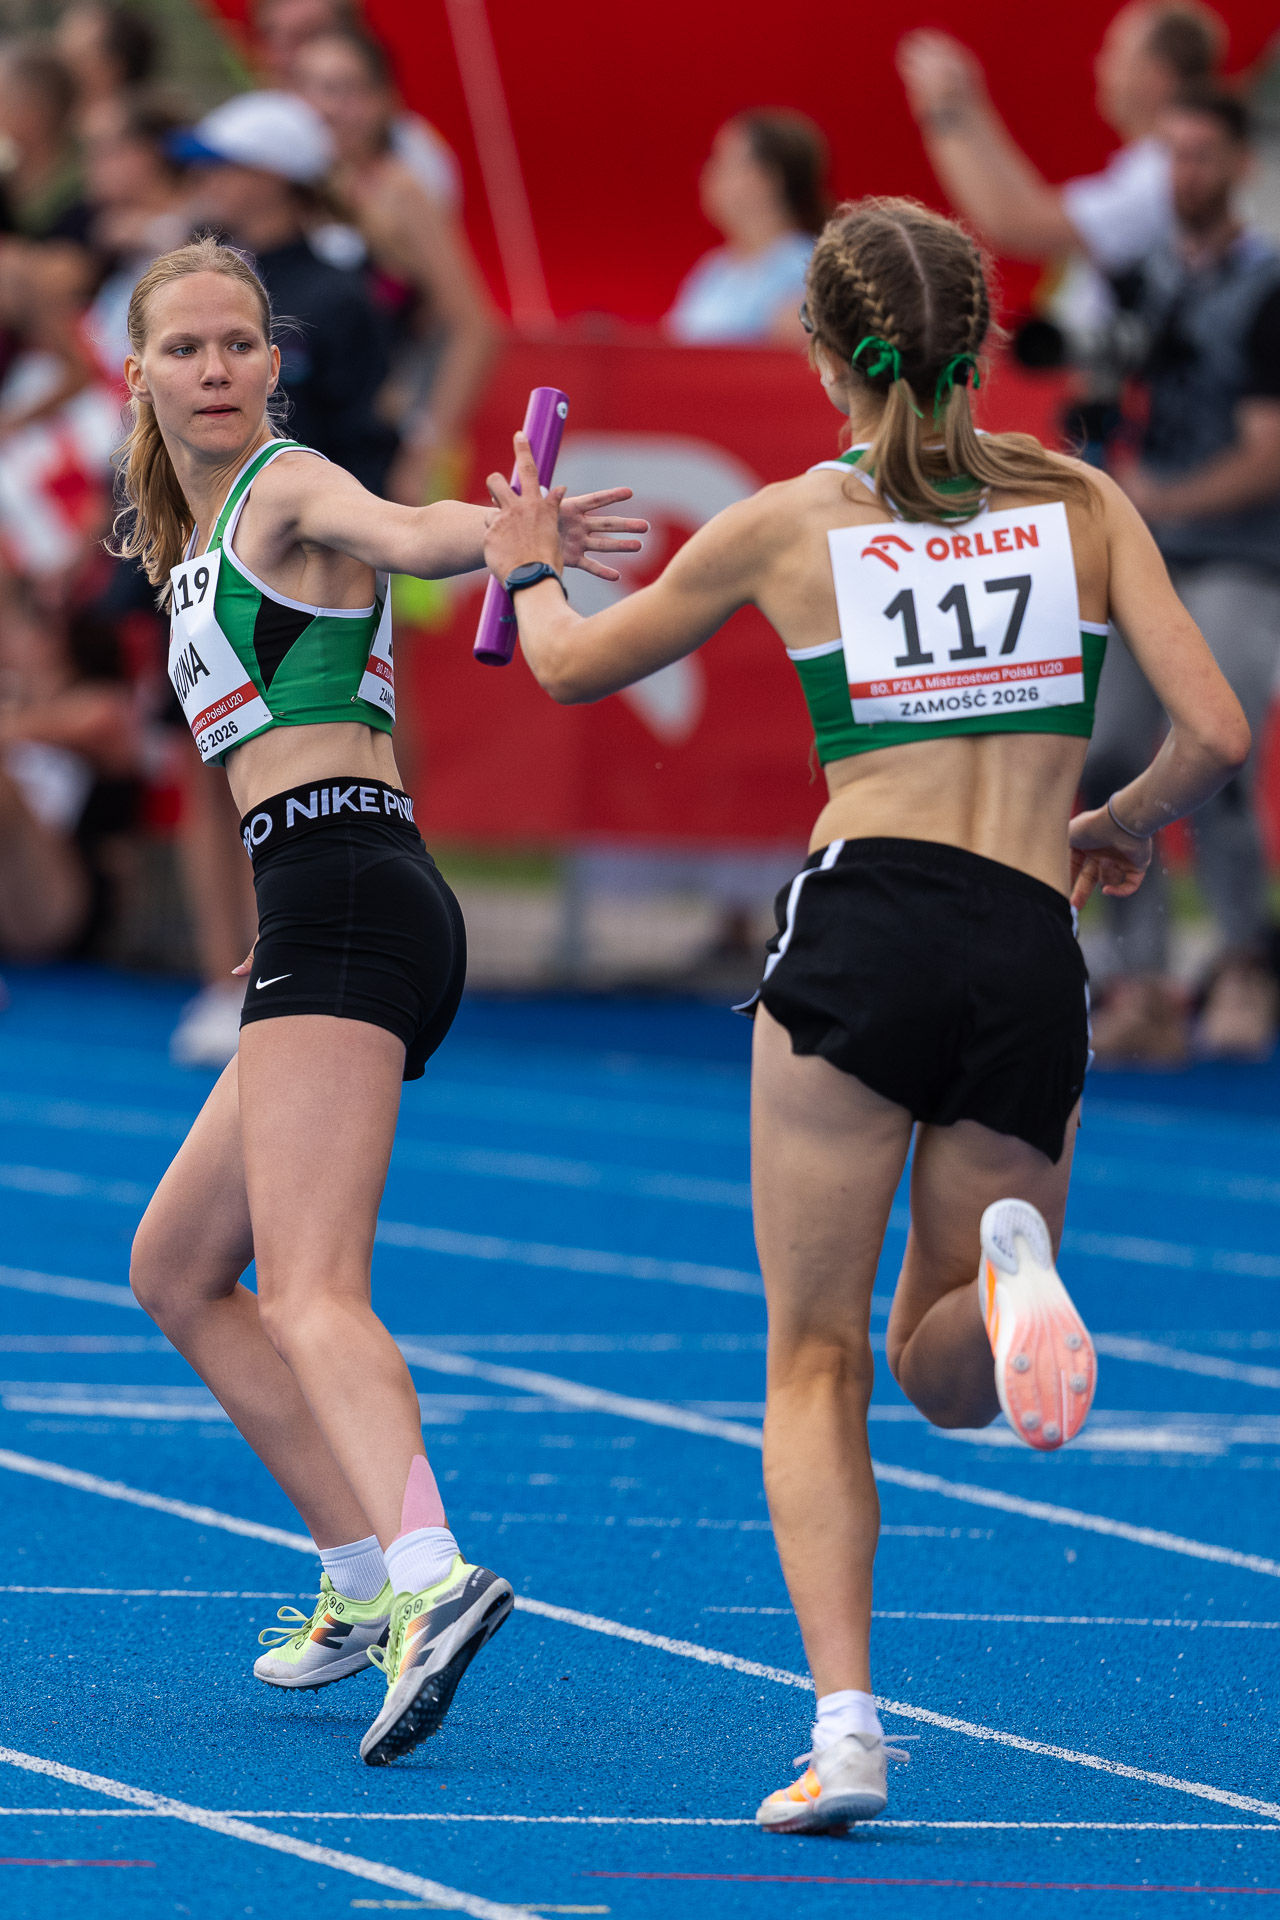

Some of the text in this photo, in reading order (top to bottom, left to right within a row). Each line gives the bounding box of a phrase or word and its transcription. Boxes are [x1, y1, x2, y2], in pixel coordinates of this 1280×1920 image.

[925, 524, 1039, 561] ORLEN
[883, 574, 1032, 668] 117
[870, 662, 1064, 696] 80. PZLA Mistrzostwa Polski U20
[206, 702, 228, 722] Polski
[227, 692, 244, 709] U20
[900, 686, 1039, 717] ZAMOŚĆ 2026
[208, 720, 239, 748] 2026
[285, 785, 381, 828] NIKE
